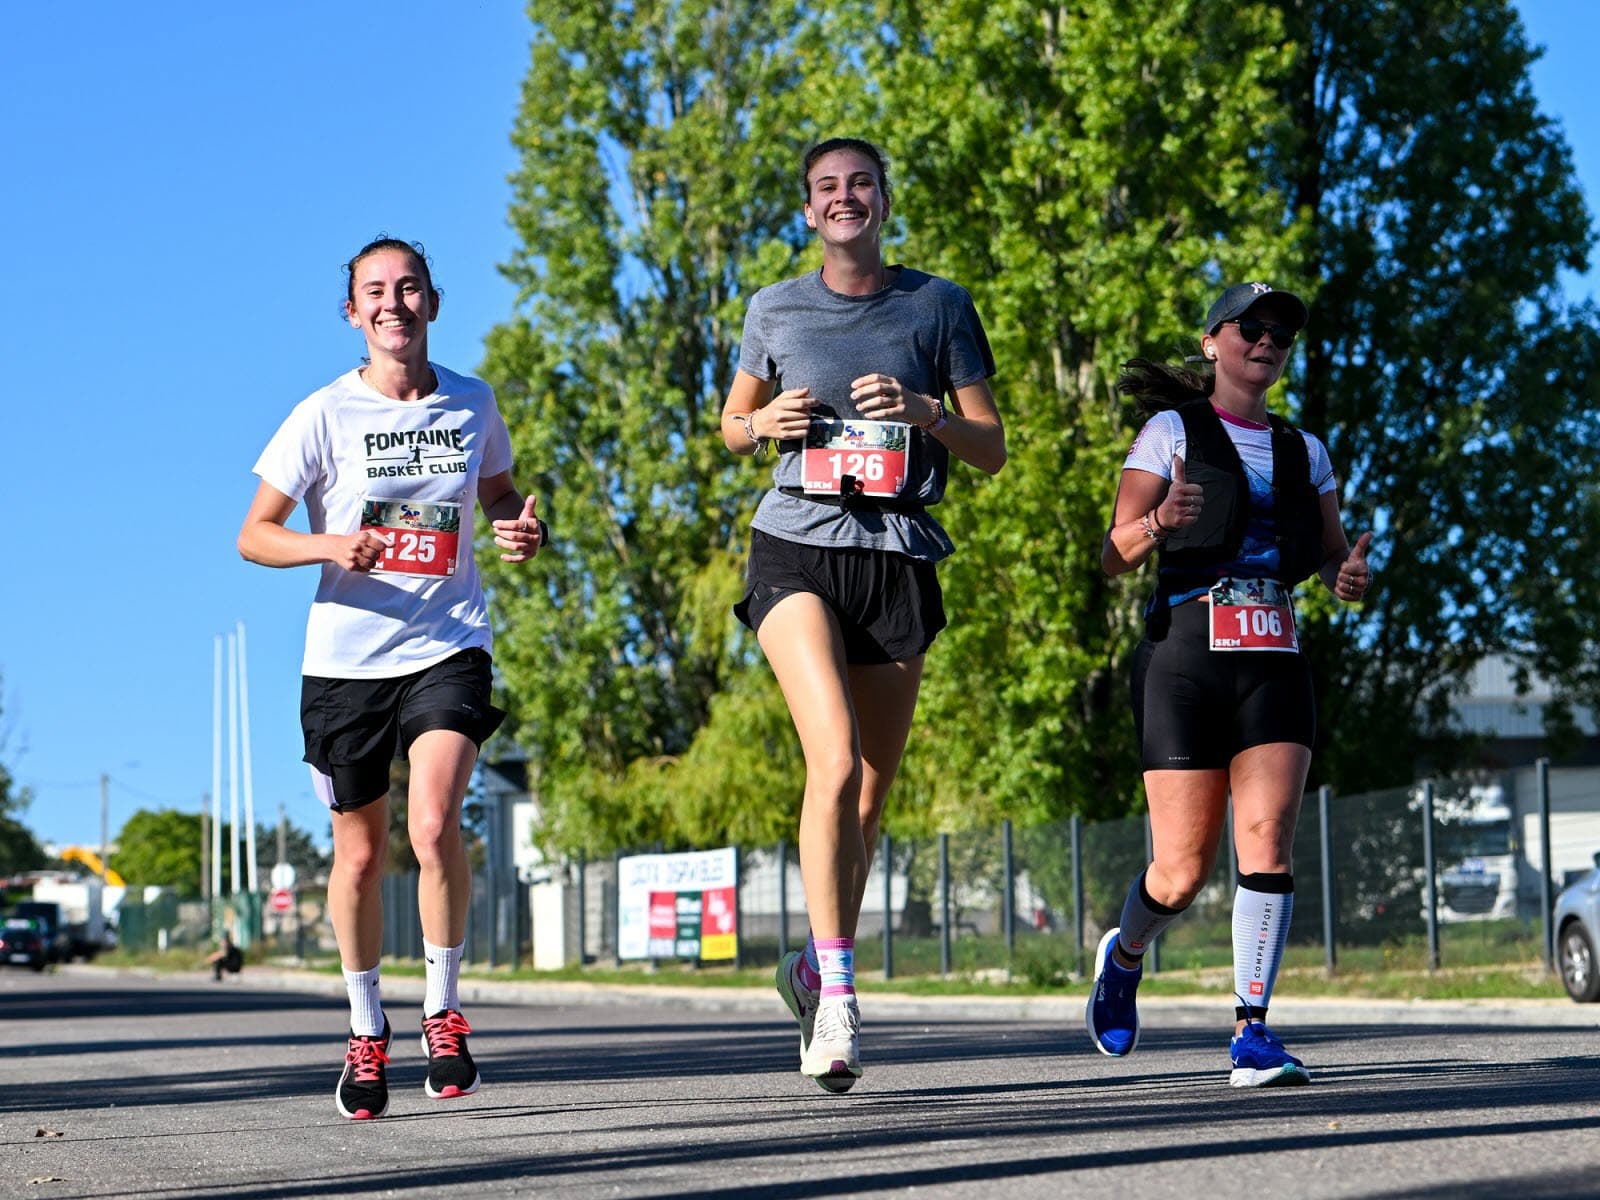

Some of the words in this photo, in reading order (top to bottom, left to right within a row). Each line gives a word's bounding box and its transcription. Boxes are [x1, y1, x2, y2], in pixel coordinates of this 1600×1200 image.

[364, 429, 464, 456] FONTAINE
[366, 465, 424, 478] BASKET
[429, 462, 468, 474] CLUB
[828, 453, 884, 481] 126
[384, 531, 436, 563] 125
[1235, 609, 1282, 636] 106
[1254, 902, 1273, 978] COMPRESSPORT
